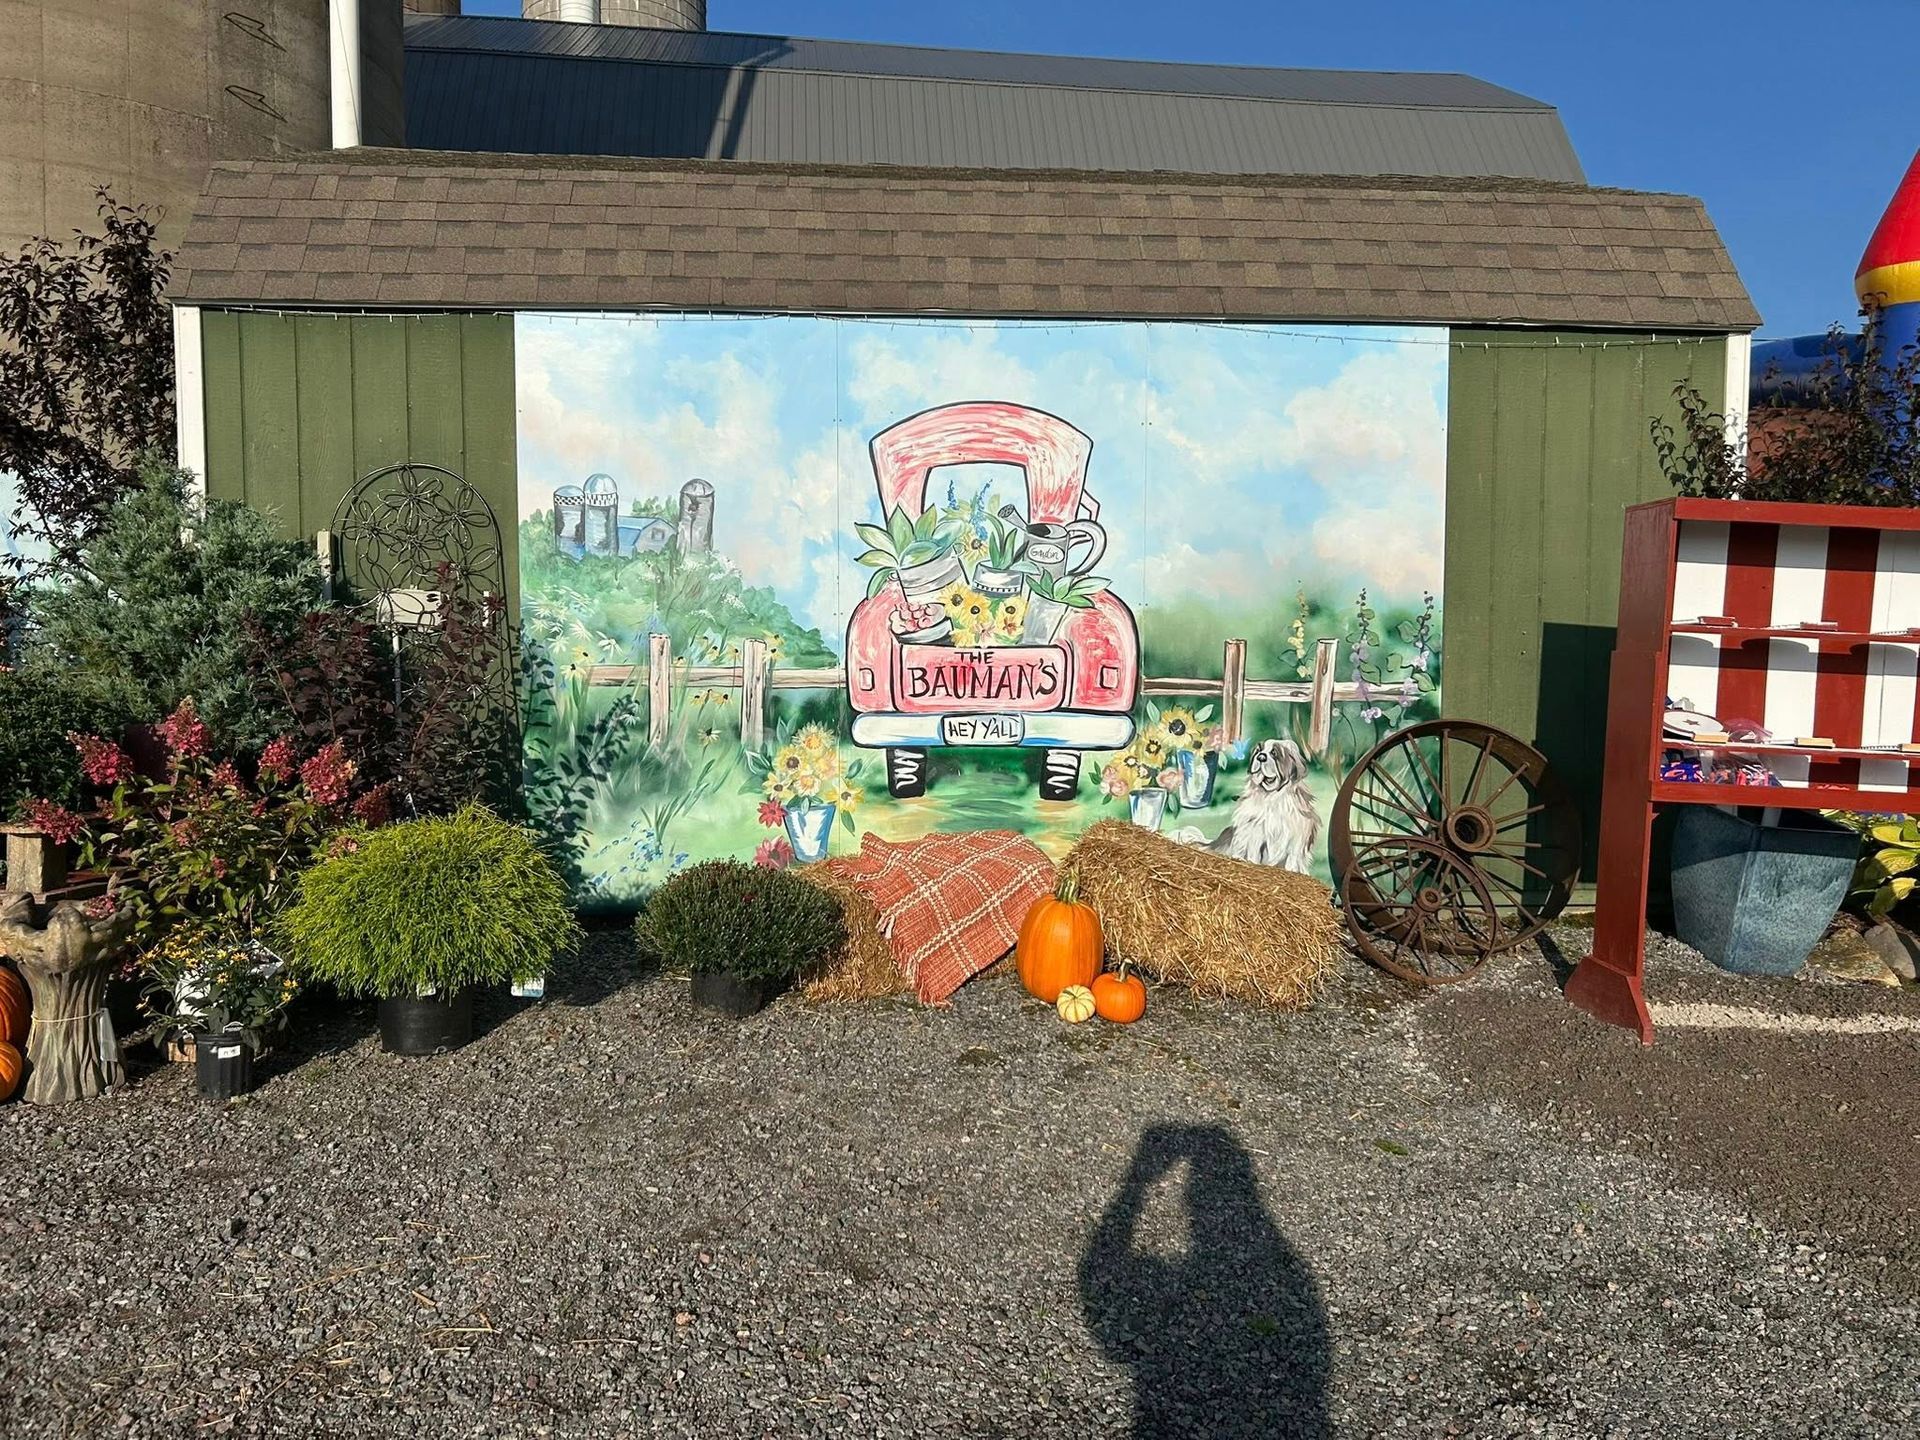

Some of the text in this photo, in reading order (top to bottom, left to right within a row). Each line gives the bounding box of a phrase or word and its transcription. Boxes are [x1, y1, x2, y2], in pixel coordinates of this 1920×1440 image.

[954, 651, 995, 665] THE
[907, 658, 1059, 700] BAUMAN'S
[948, 716, 1019, 739] HEY Y'ALL
